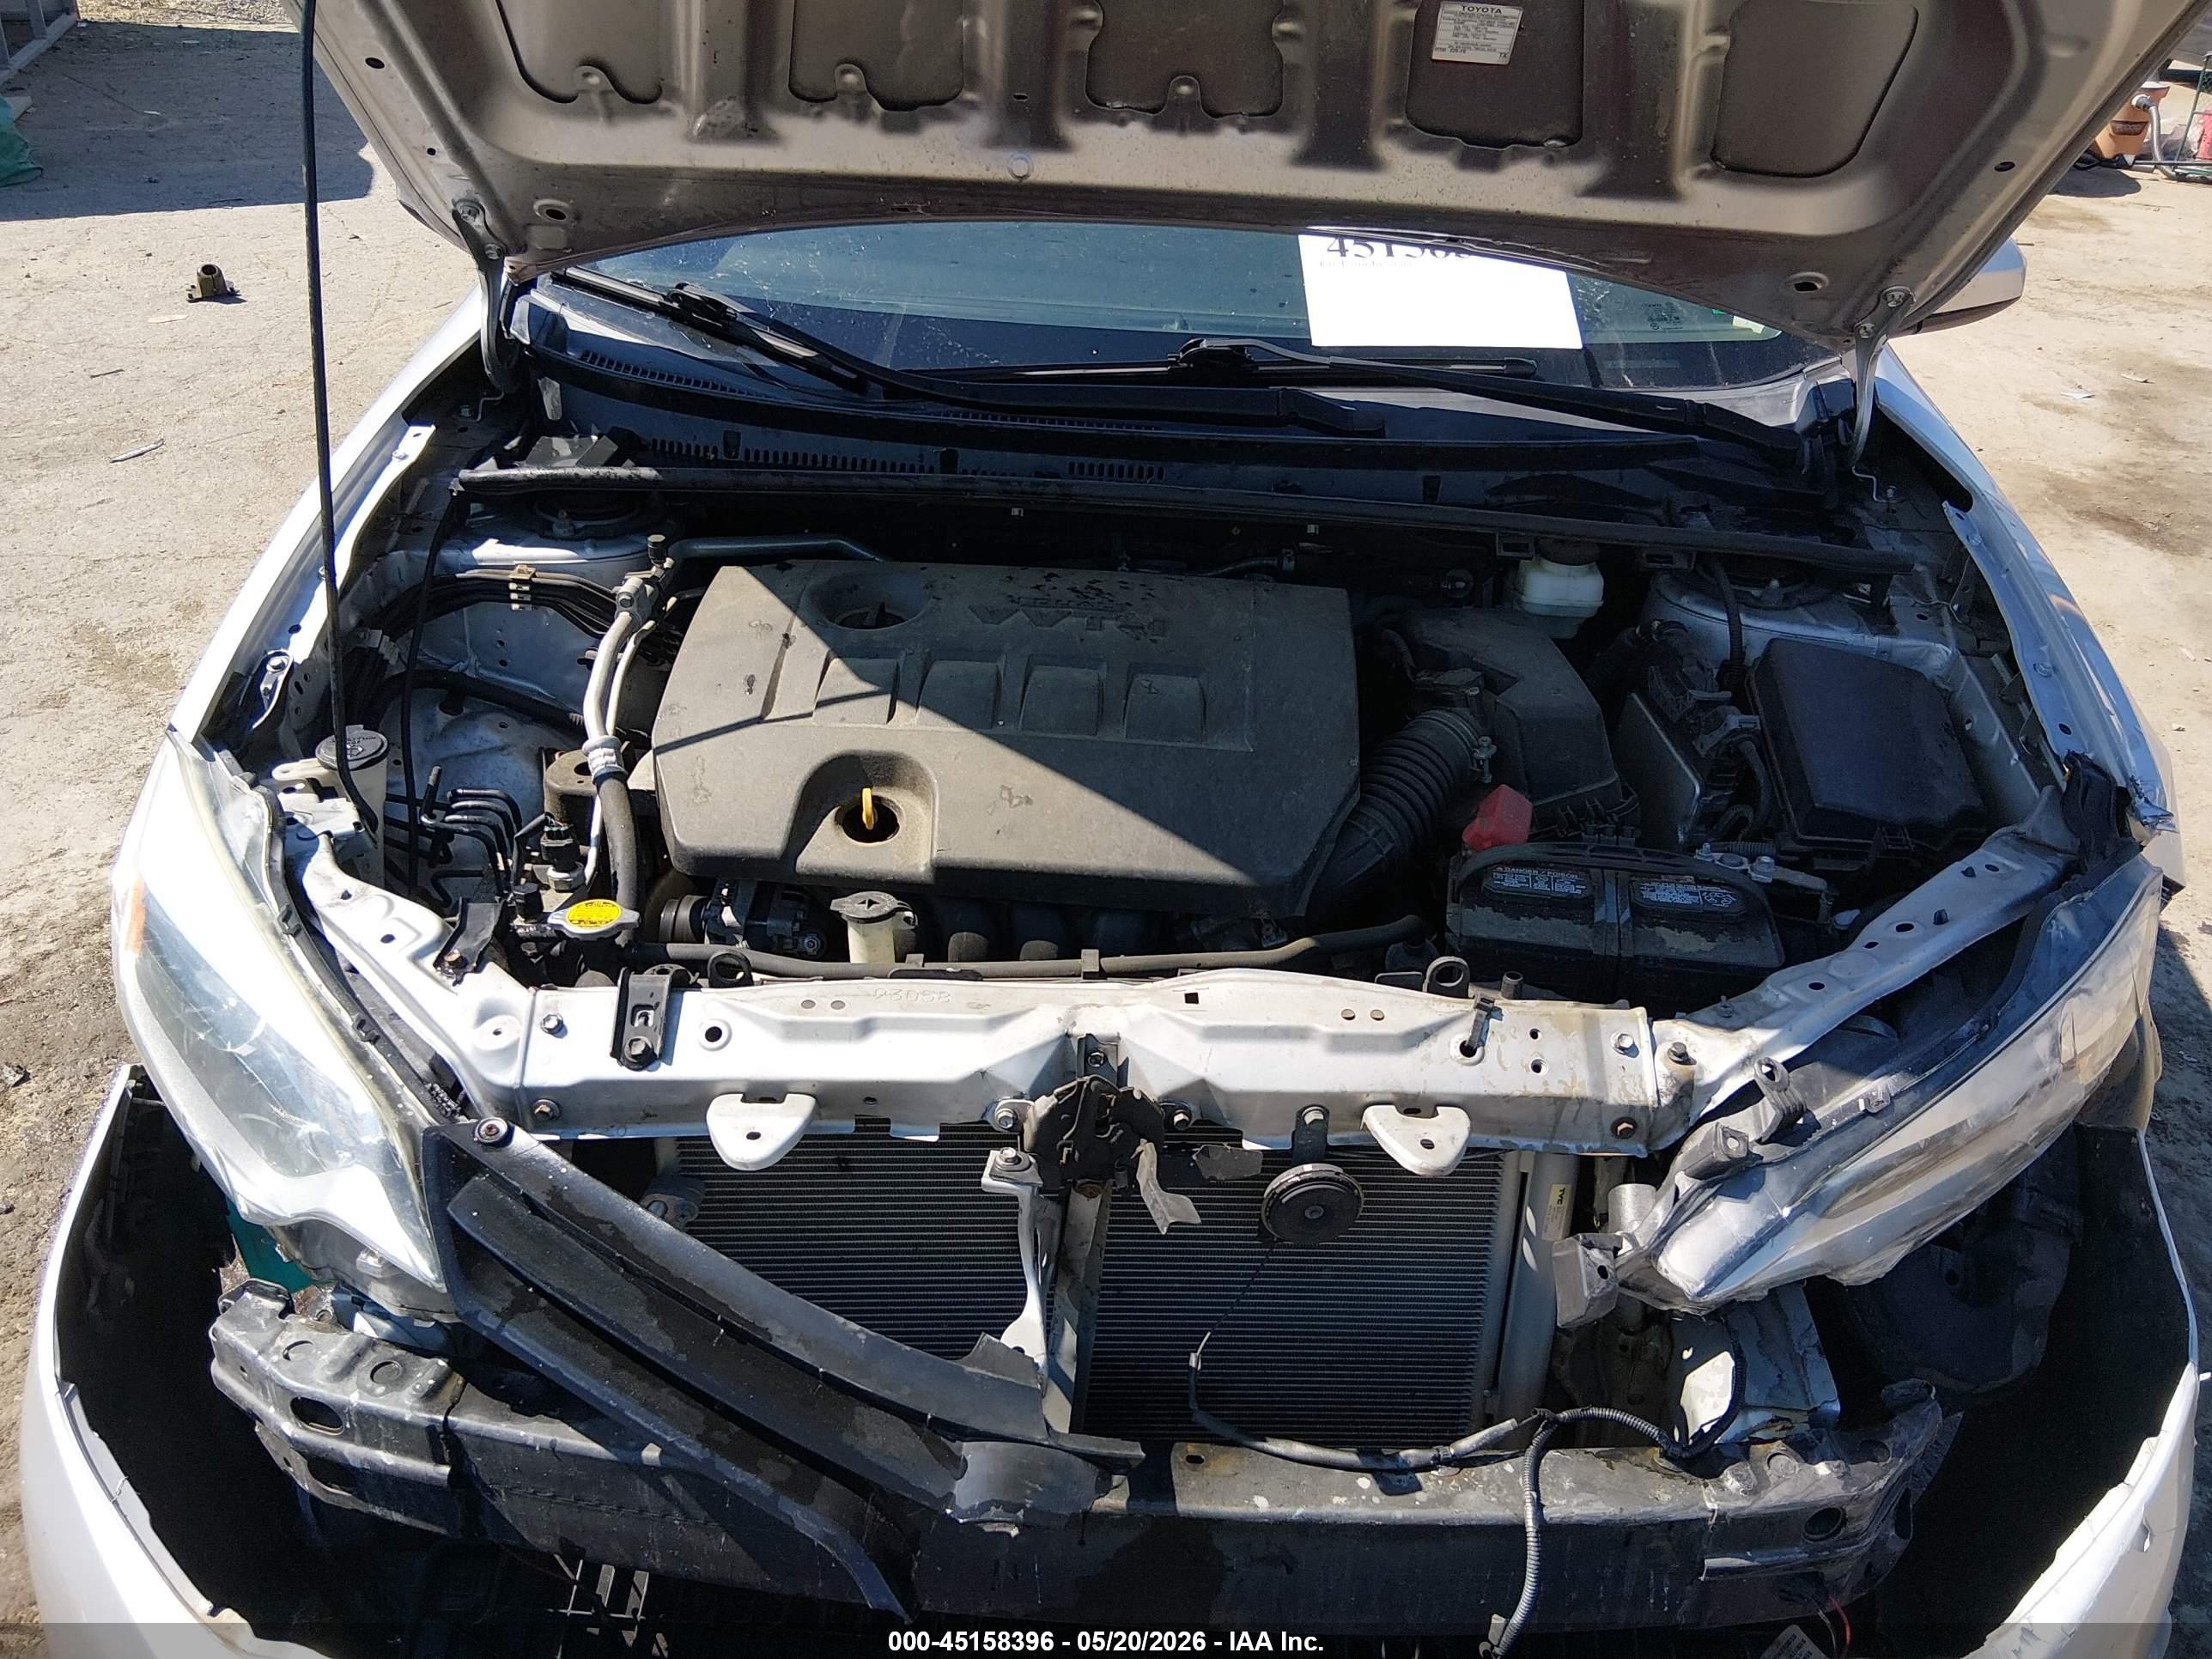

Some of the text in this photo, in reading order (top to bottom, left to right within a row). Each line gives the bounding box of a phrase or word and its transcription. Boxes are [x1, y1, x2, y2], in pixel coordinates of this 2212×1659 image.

[1462, 5, 1502, 14] TOYOTA
[1326, 235, 1470, 258] 451
[1557, 1188, 1566, 1205] TYC
